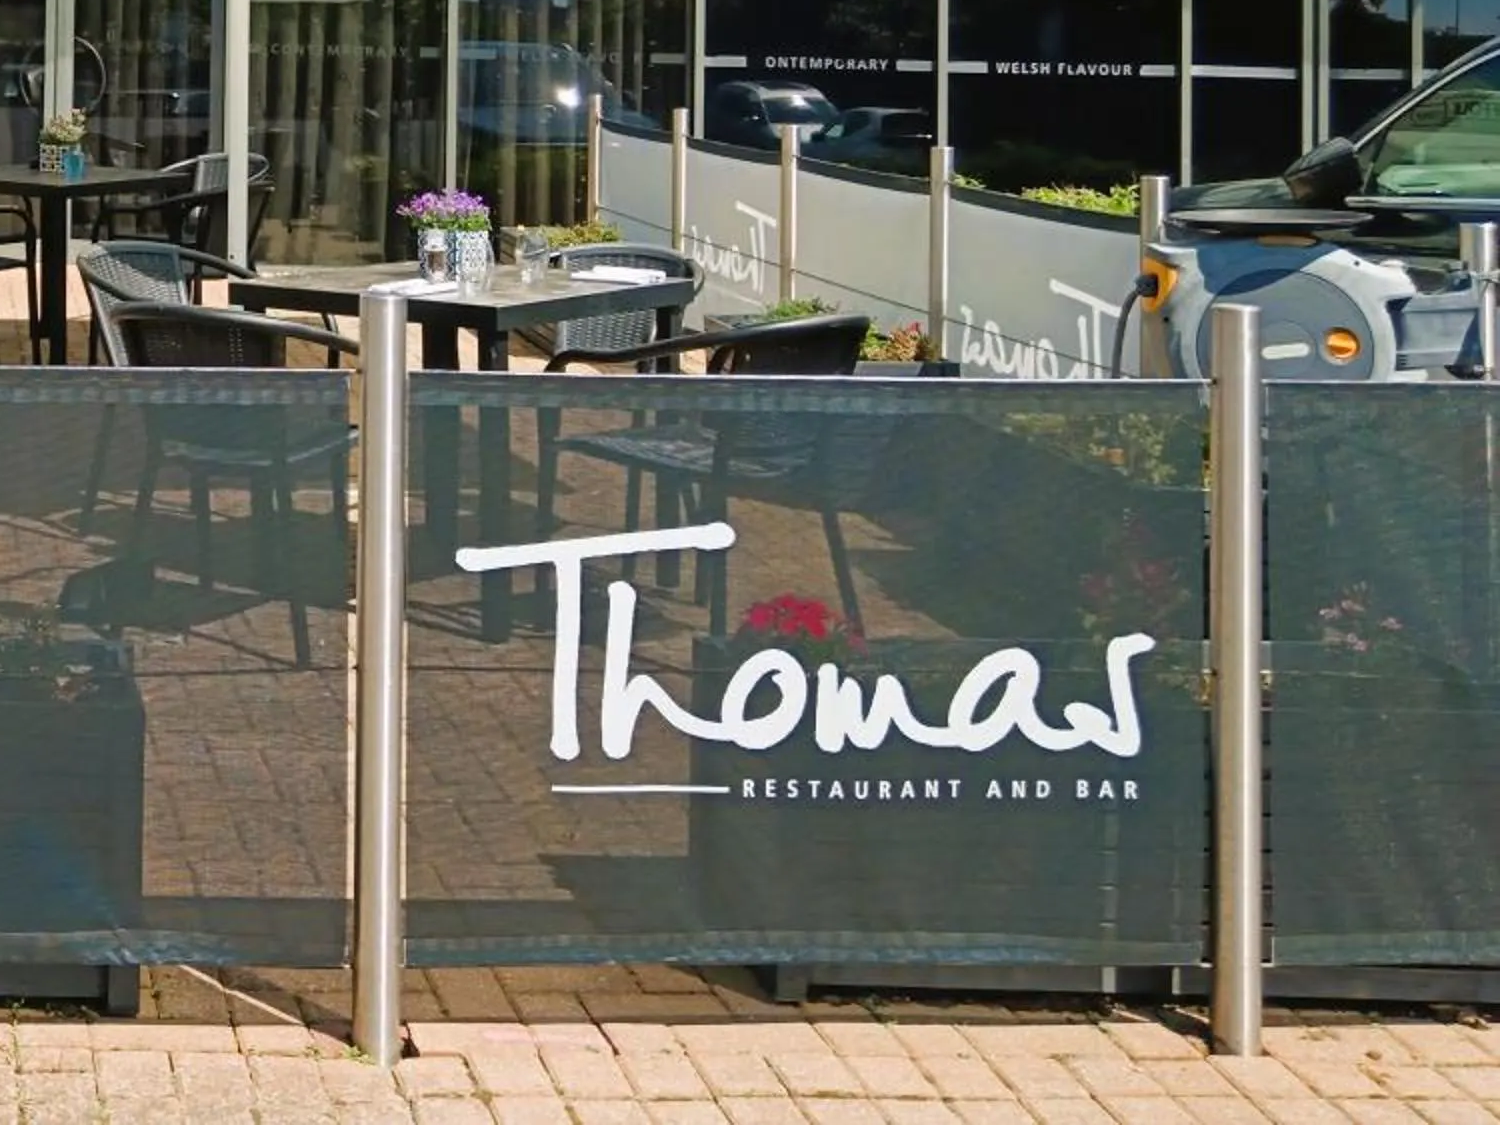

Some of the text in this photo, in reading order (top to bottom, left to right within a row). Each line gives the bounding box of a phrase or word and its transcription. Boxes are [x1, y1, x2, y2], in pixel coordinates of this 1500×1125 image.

[995, 61, 1132, 76] WELSH FLAVOUR
[454, 521, 1157, 761] Thomas
[742, 777, 1139, 801] RESTAURANT AND BAR
